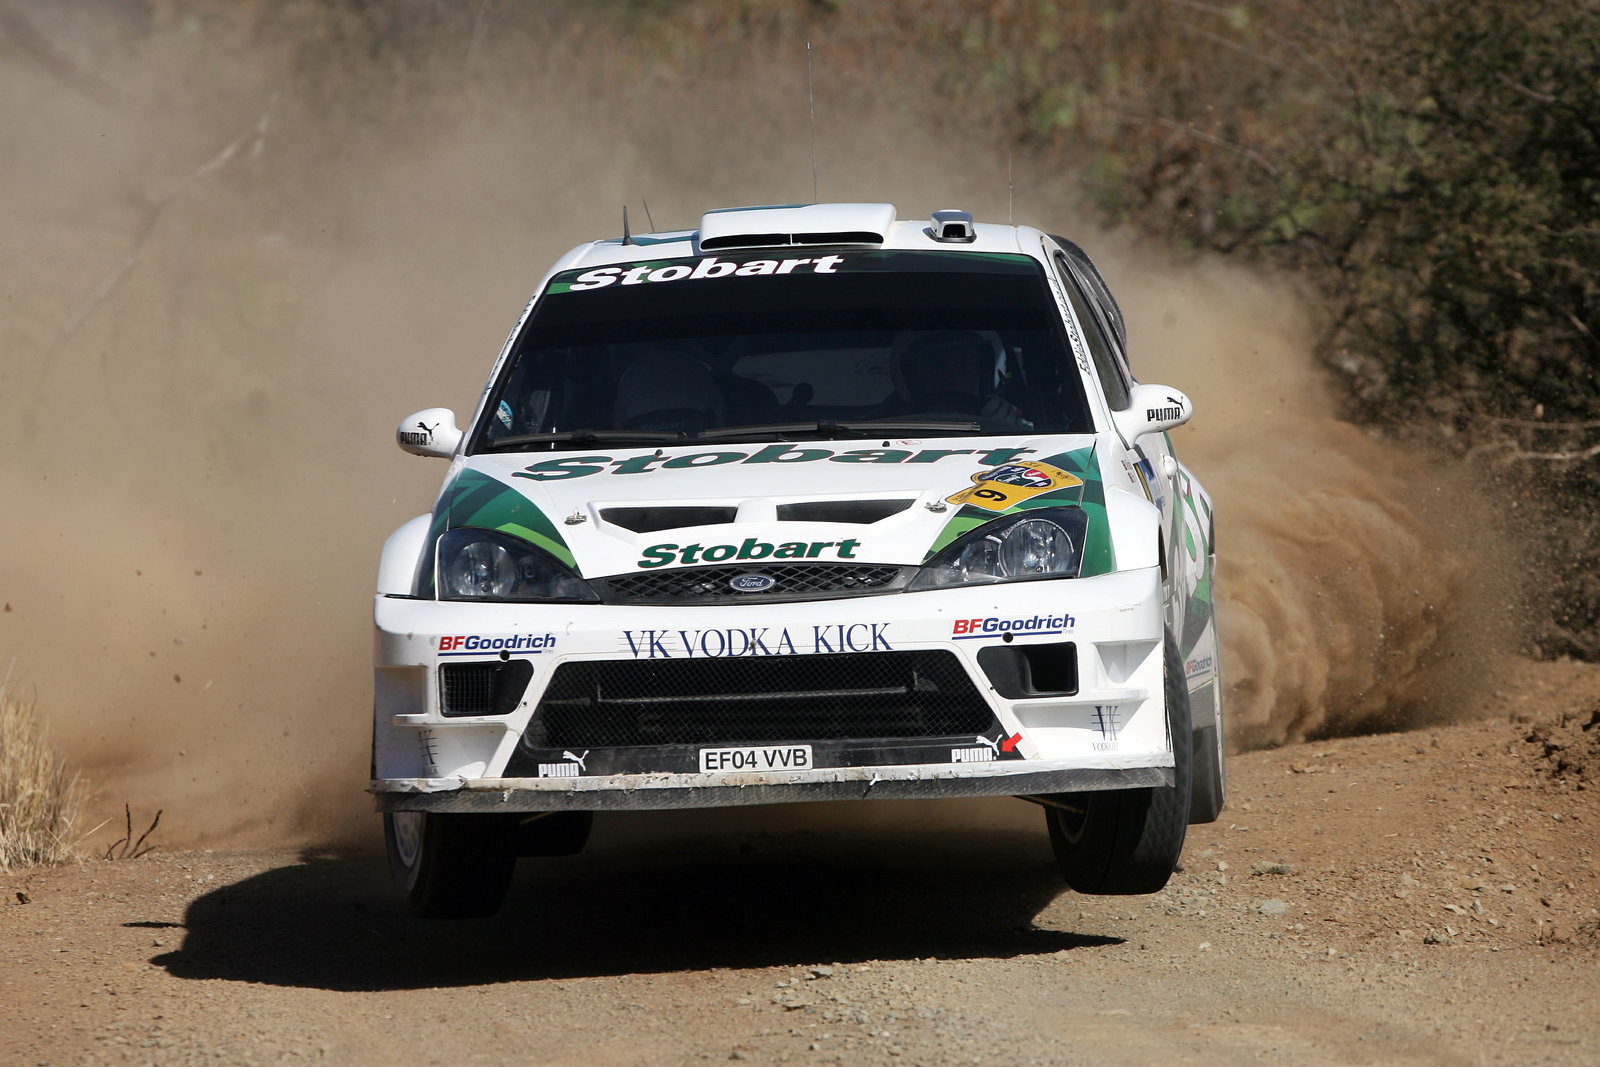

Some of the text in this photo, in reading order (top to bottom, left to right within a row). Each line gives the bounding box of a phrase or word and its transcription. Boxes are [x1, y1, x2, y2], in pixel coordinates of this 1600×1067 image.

[569, 255, 844, 292] Stobart
[1146, 406, 1180, 422] PUMA
[400, 431, 427, 446] PUMA
[513, 444, 1037, 482] Stobart
[638, 537, 861, 569] Stobart
[739, 577, 764, 587] Ford
[953, 613, 1075, 634] BFGoodrich
[438, 633, 556, 651] BFGoodrich
[622, 622, 893, 659] VK VODKA KICK
[706, 748, 807, 770] EF04 VVB
[951, 747, 993, 763] PUMA
[538, 762, 580, 778] PUMA
